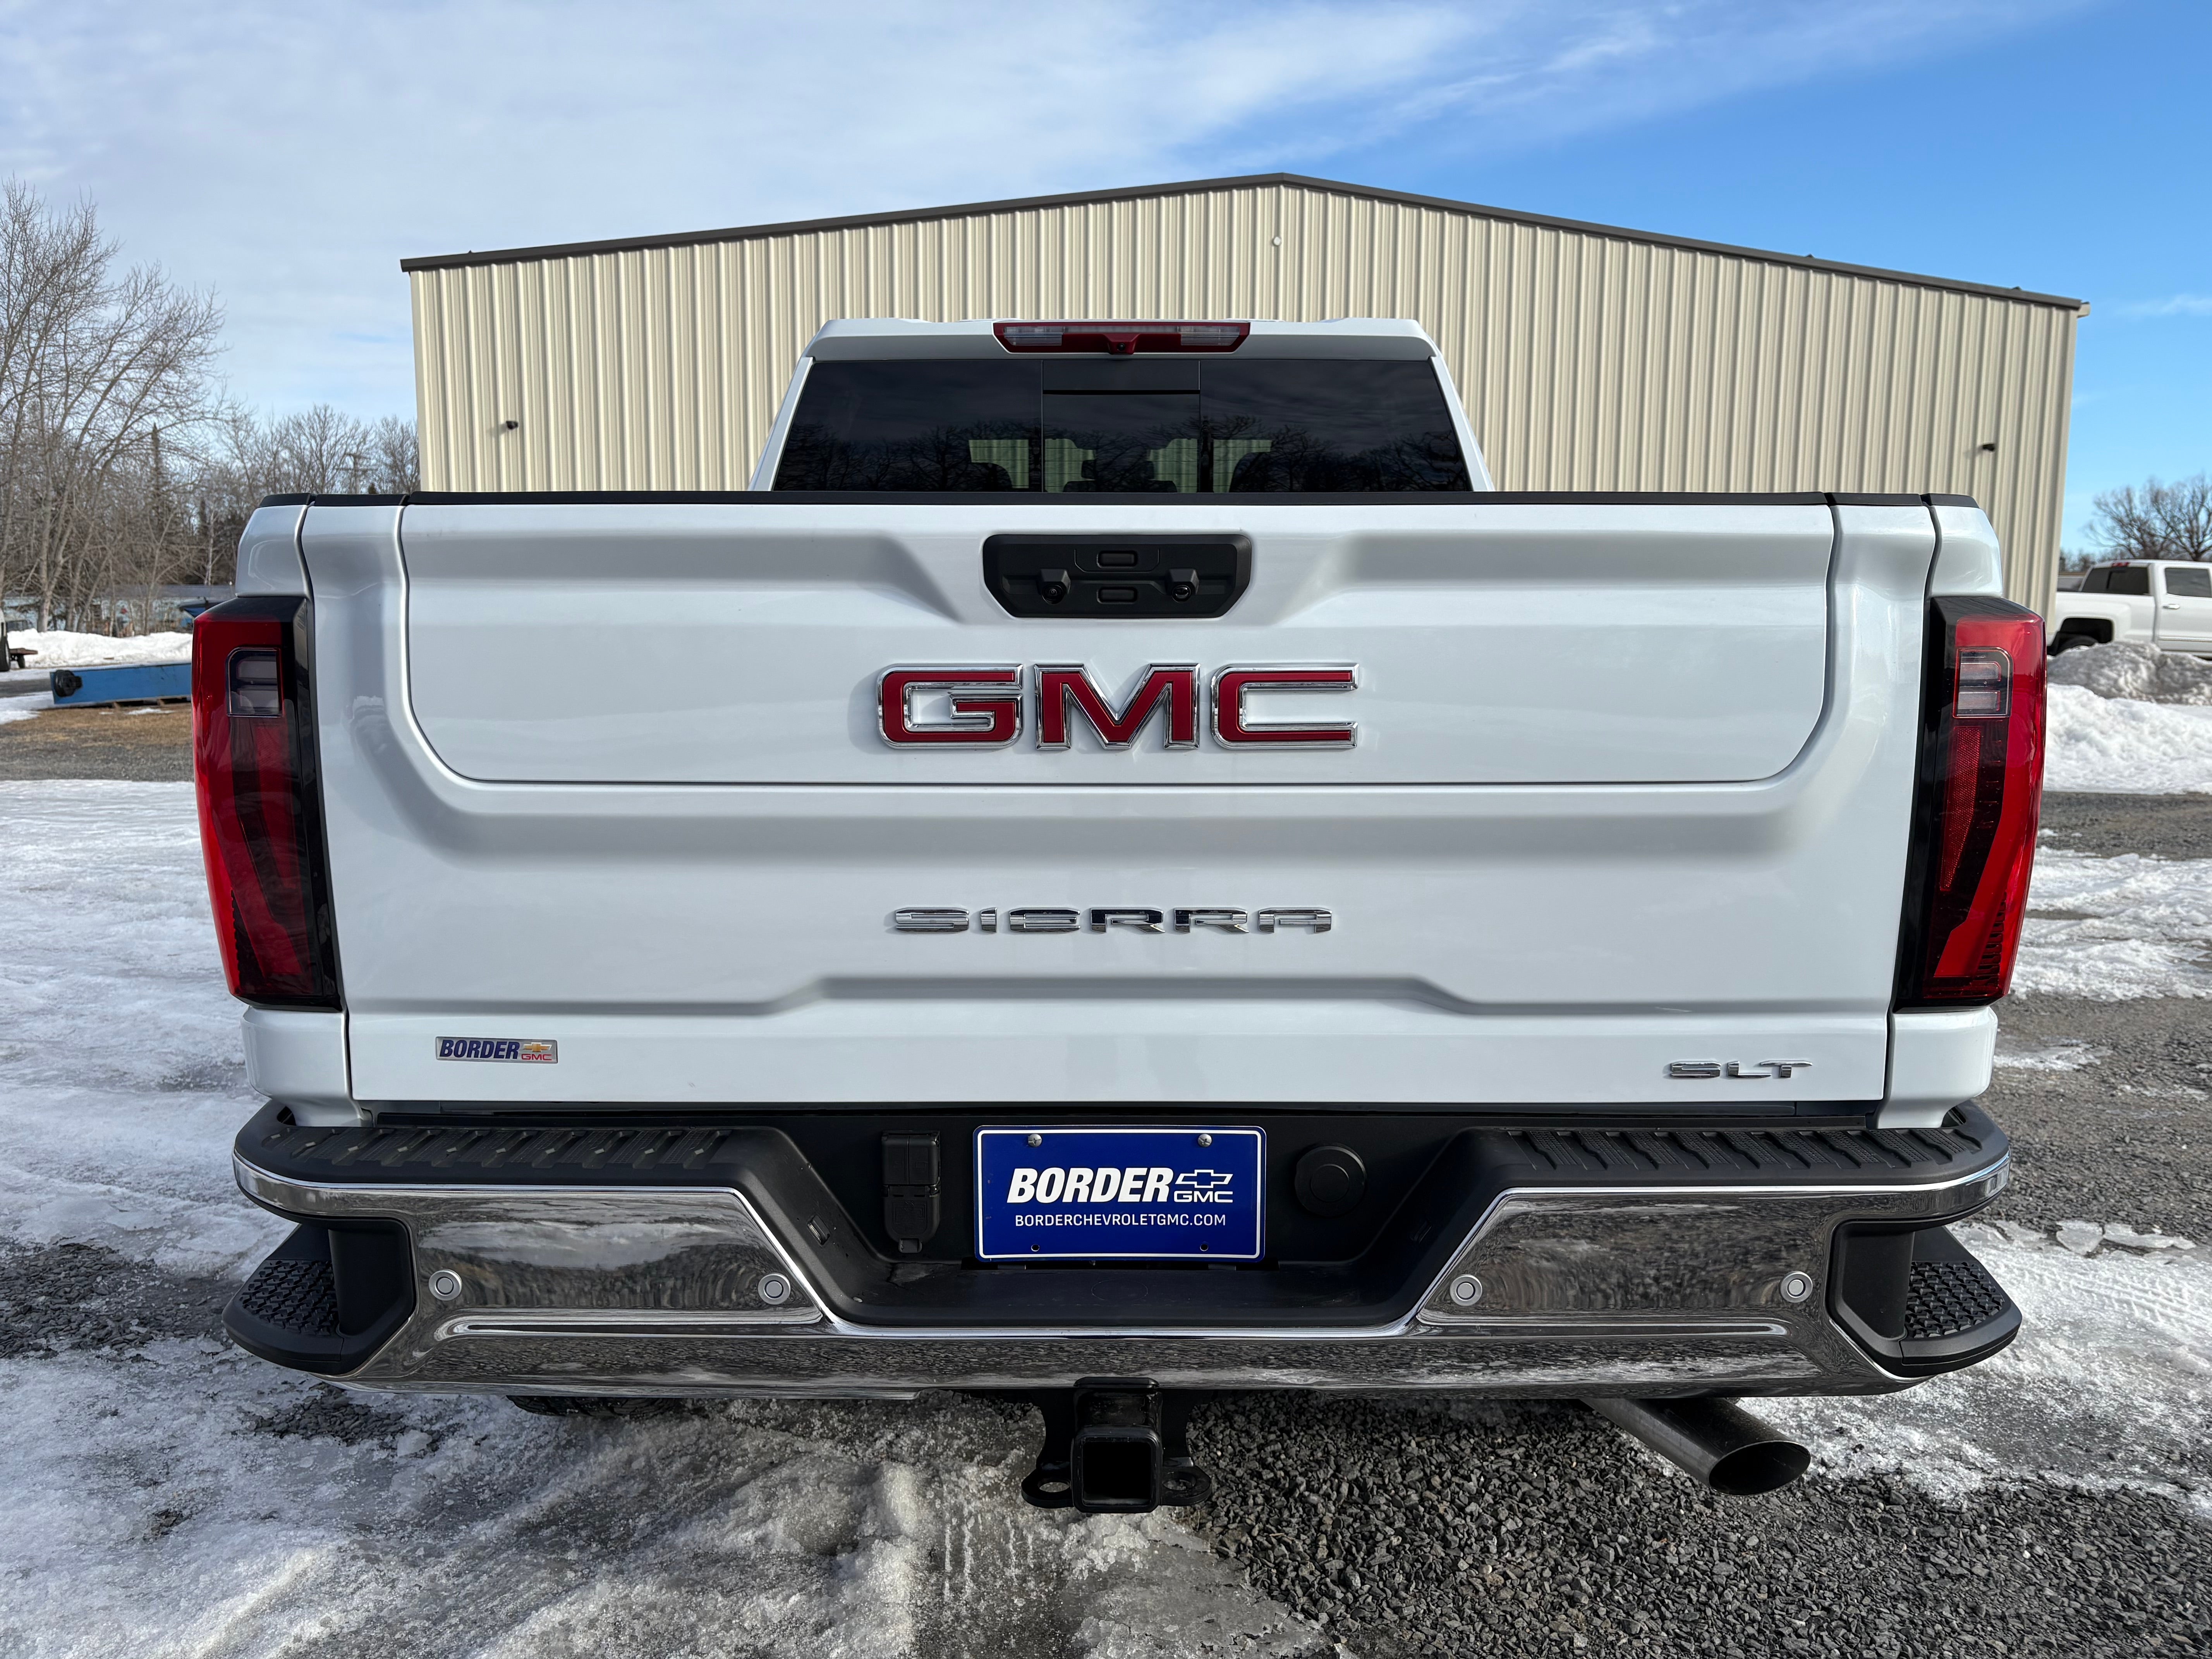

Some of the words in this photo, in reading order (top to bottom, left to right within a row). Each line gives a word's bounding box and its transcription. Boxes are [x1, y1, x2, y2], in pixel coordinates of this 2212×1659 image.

[876, 663, 1359, 750] GMC
[895, 907, 1332, 933] SIERRA
[440, 1039, 520, 1059] BORDER
[1670, 1060, 1813, 1078] SLT
[1007, 1167, 1174, 1203] BORDER
[1174, 1191, 1233, 1203] GMC
[1015, 1214, 1226, 1226] BORDERCHEVROLETGMC.COM
